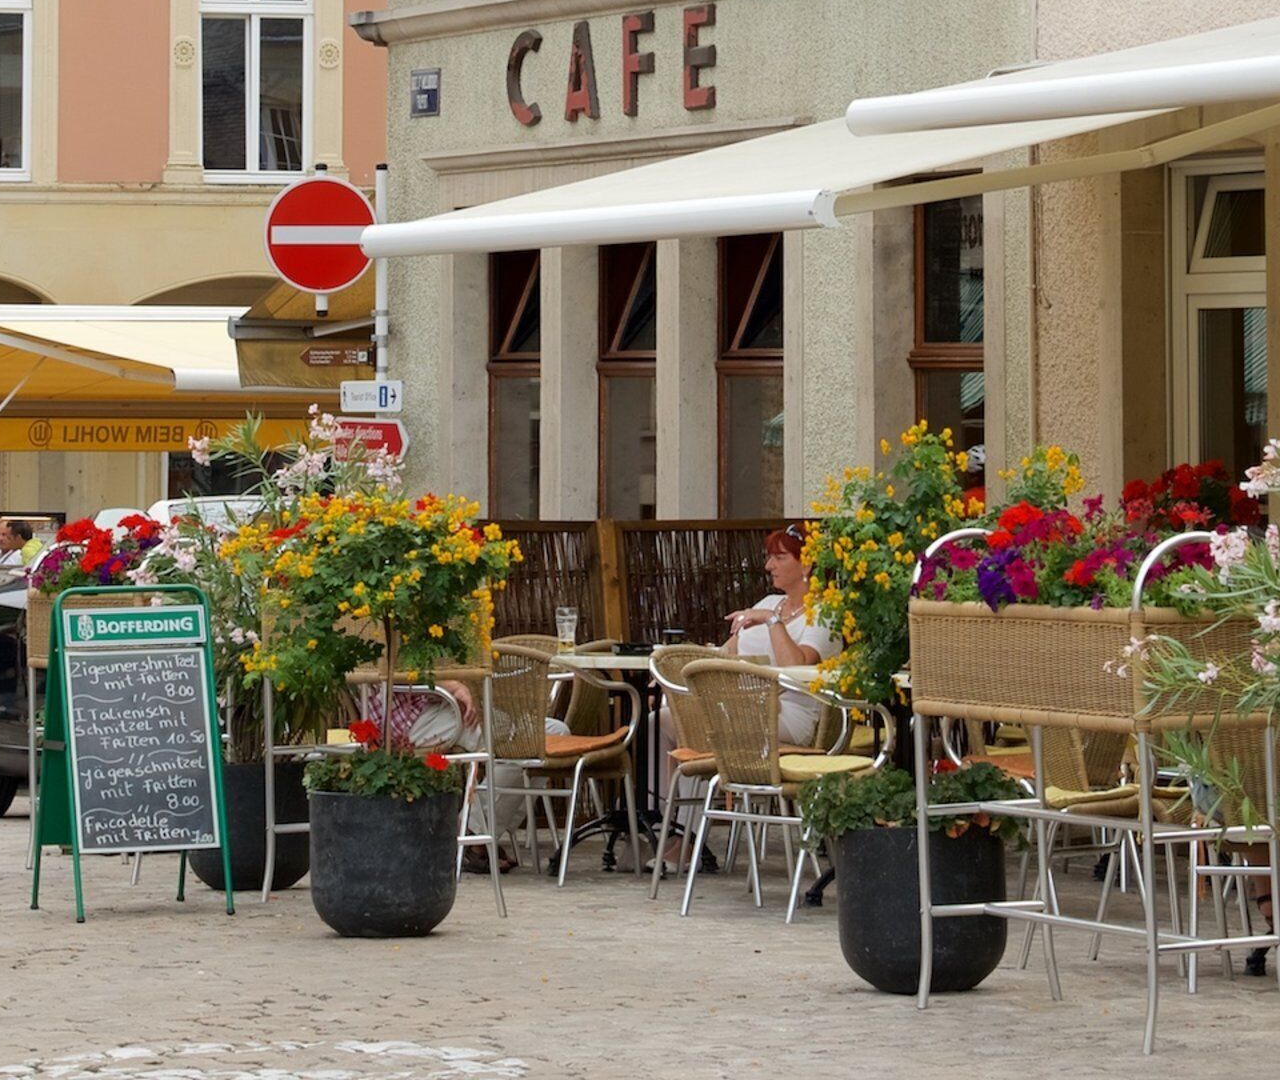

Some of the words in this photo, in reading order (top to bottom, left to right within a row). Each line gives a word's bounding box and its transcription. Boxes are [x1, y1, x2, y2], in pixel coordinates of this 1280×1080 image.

[506, 2, 717, 127] CAFE
[96, 616, 193, 634] BOFFERDING
[104, 674, 134, 690] mit
[159, 710, 188, 728] mit
[100, 781, 133, 800] mit
[95, 828, 129, 845] mit
